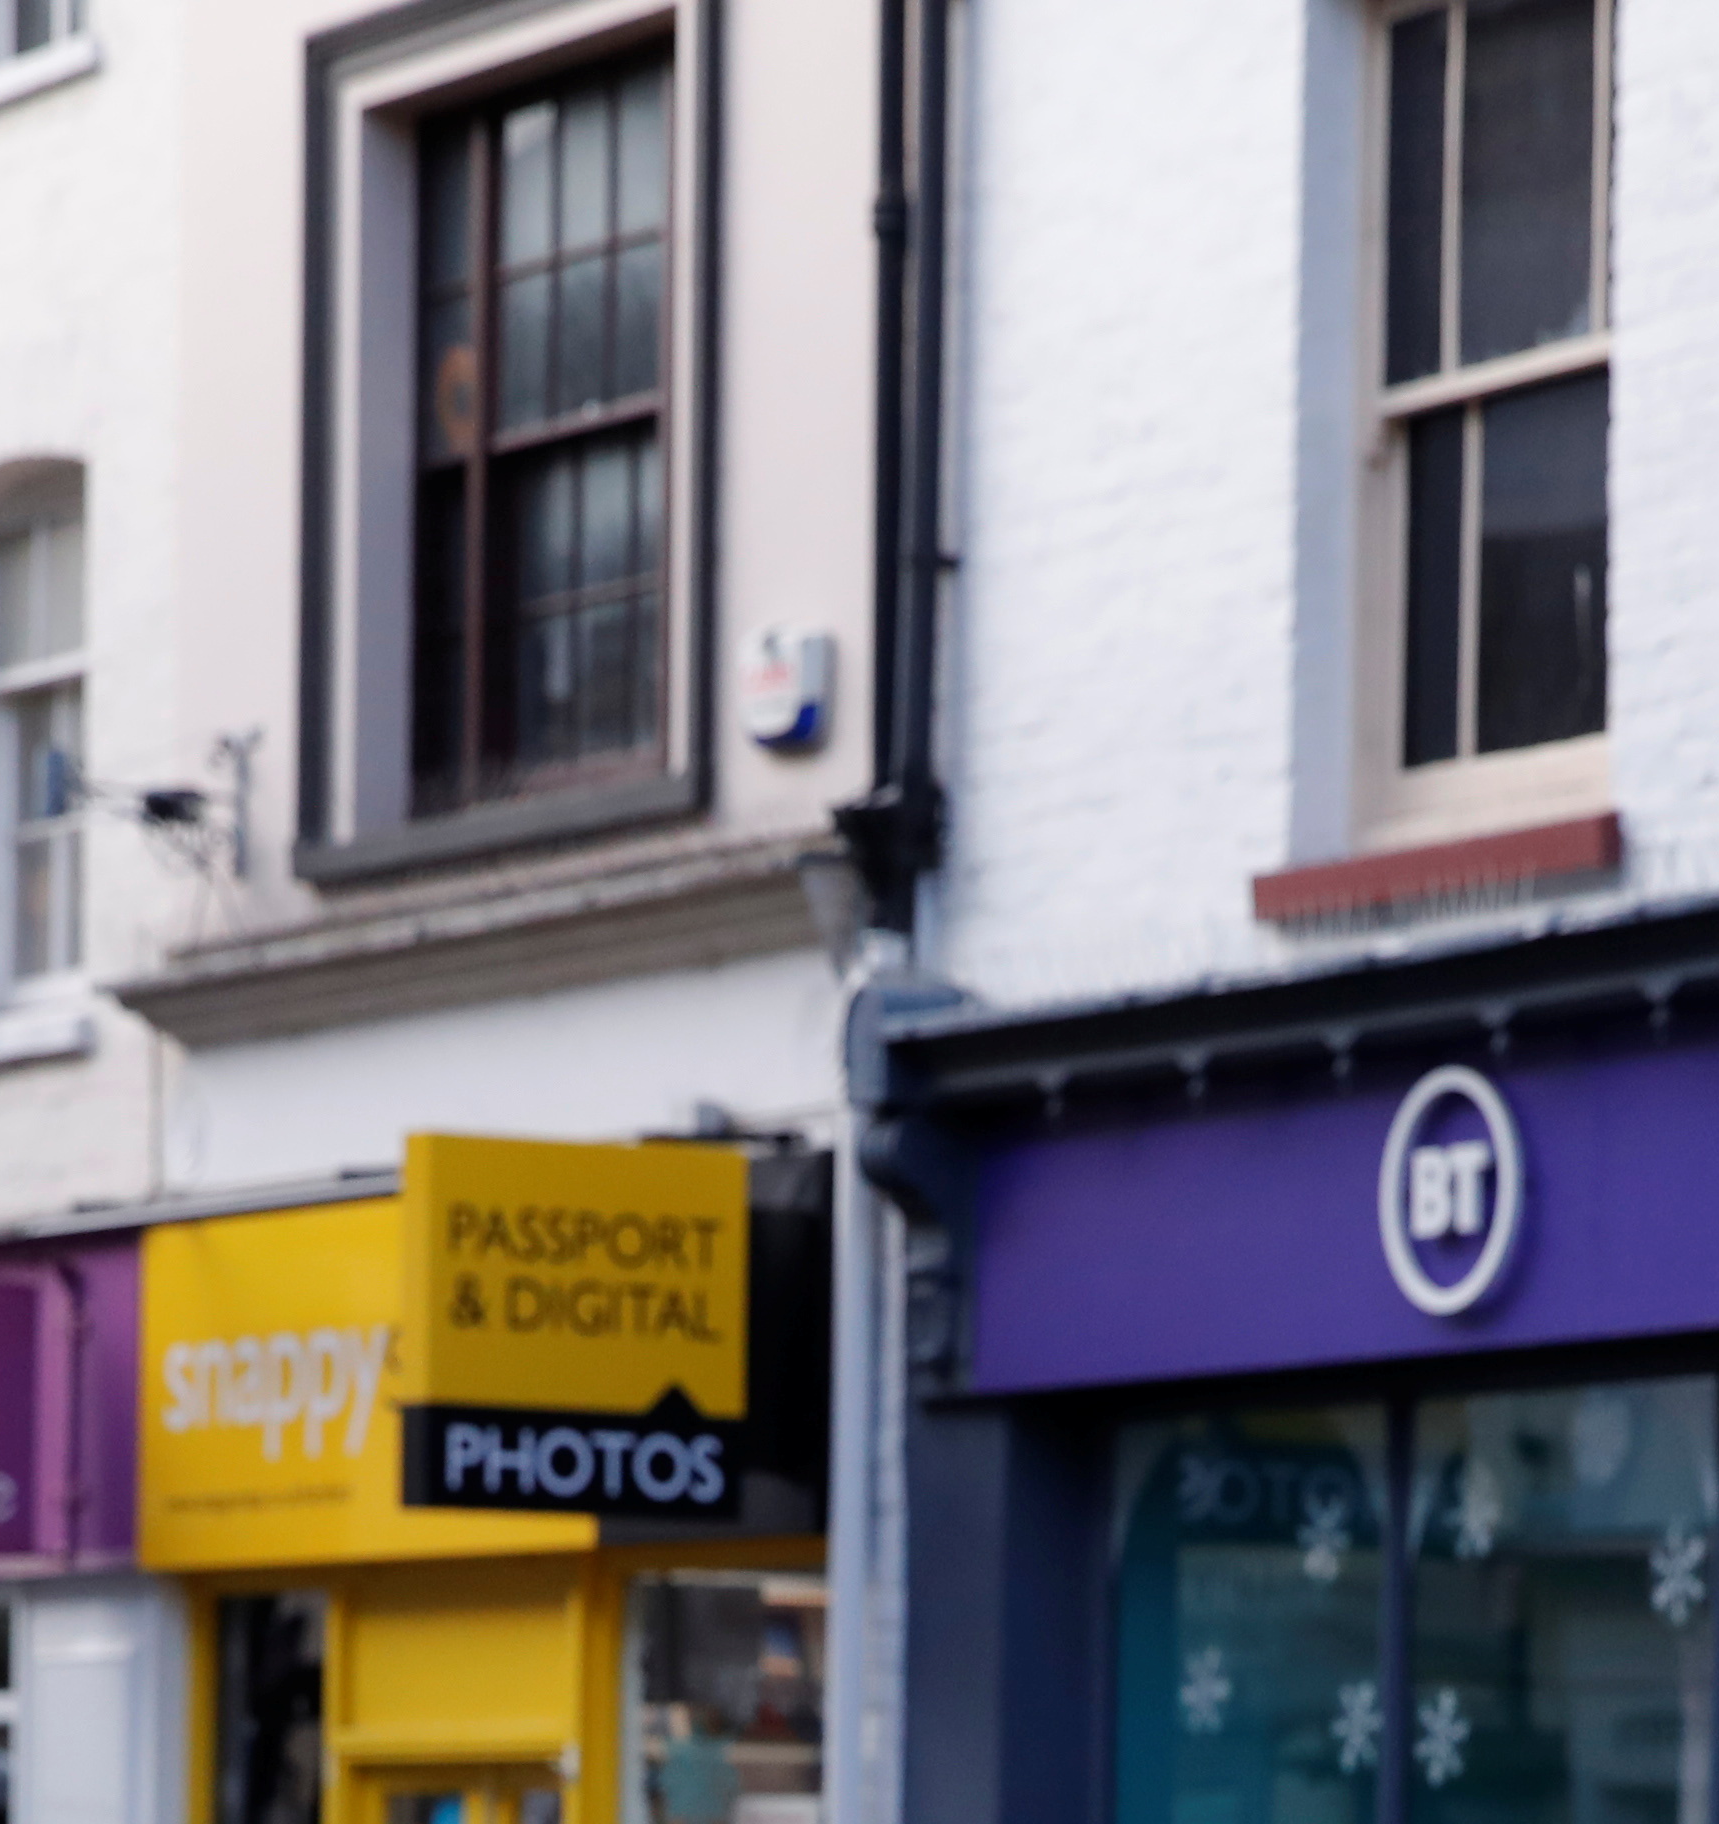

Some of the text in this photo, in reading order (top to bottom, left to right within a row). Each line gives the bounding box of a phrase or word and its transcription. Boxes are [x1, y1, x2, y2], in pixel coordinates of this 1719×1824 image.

[1408, 1138, 1495, 1242] BT
[448, 1203, 724, 1270] PASSPORT
[451, 1276, 722, 1343] & DIGITAL
[162, 1322, 387, 1462] snappy
[444, 1422, 725, 1504] PHOTOS
